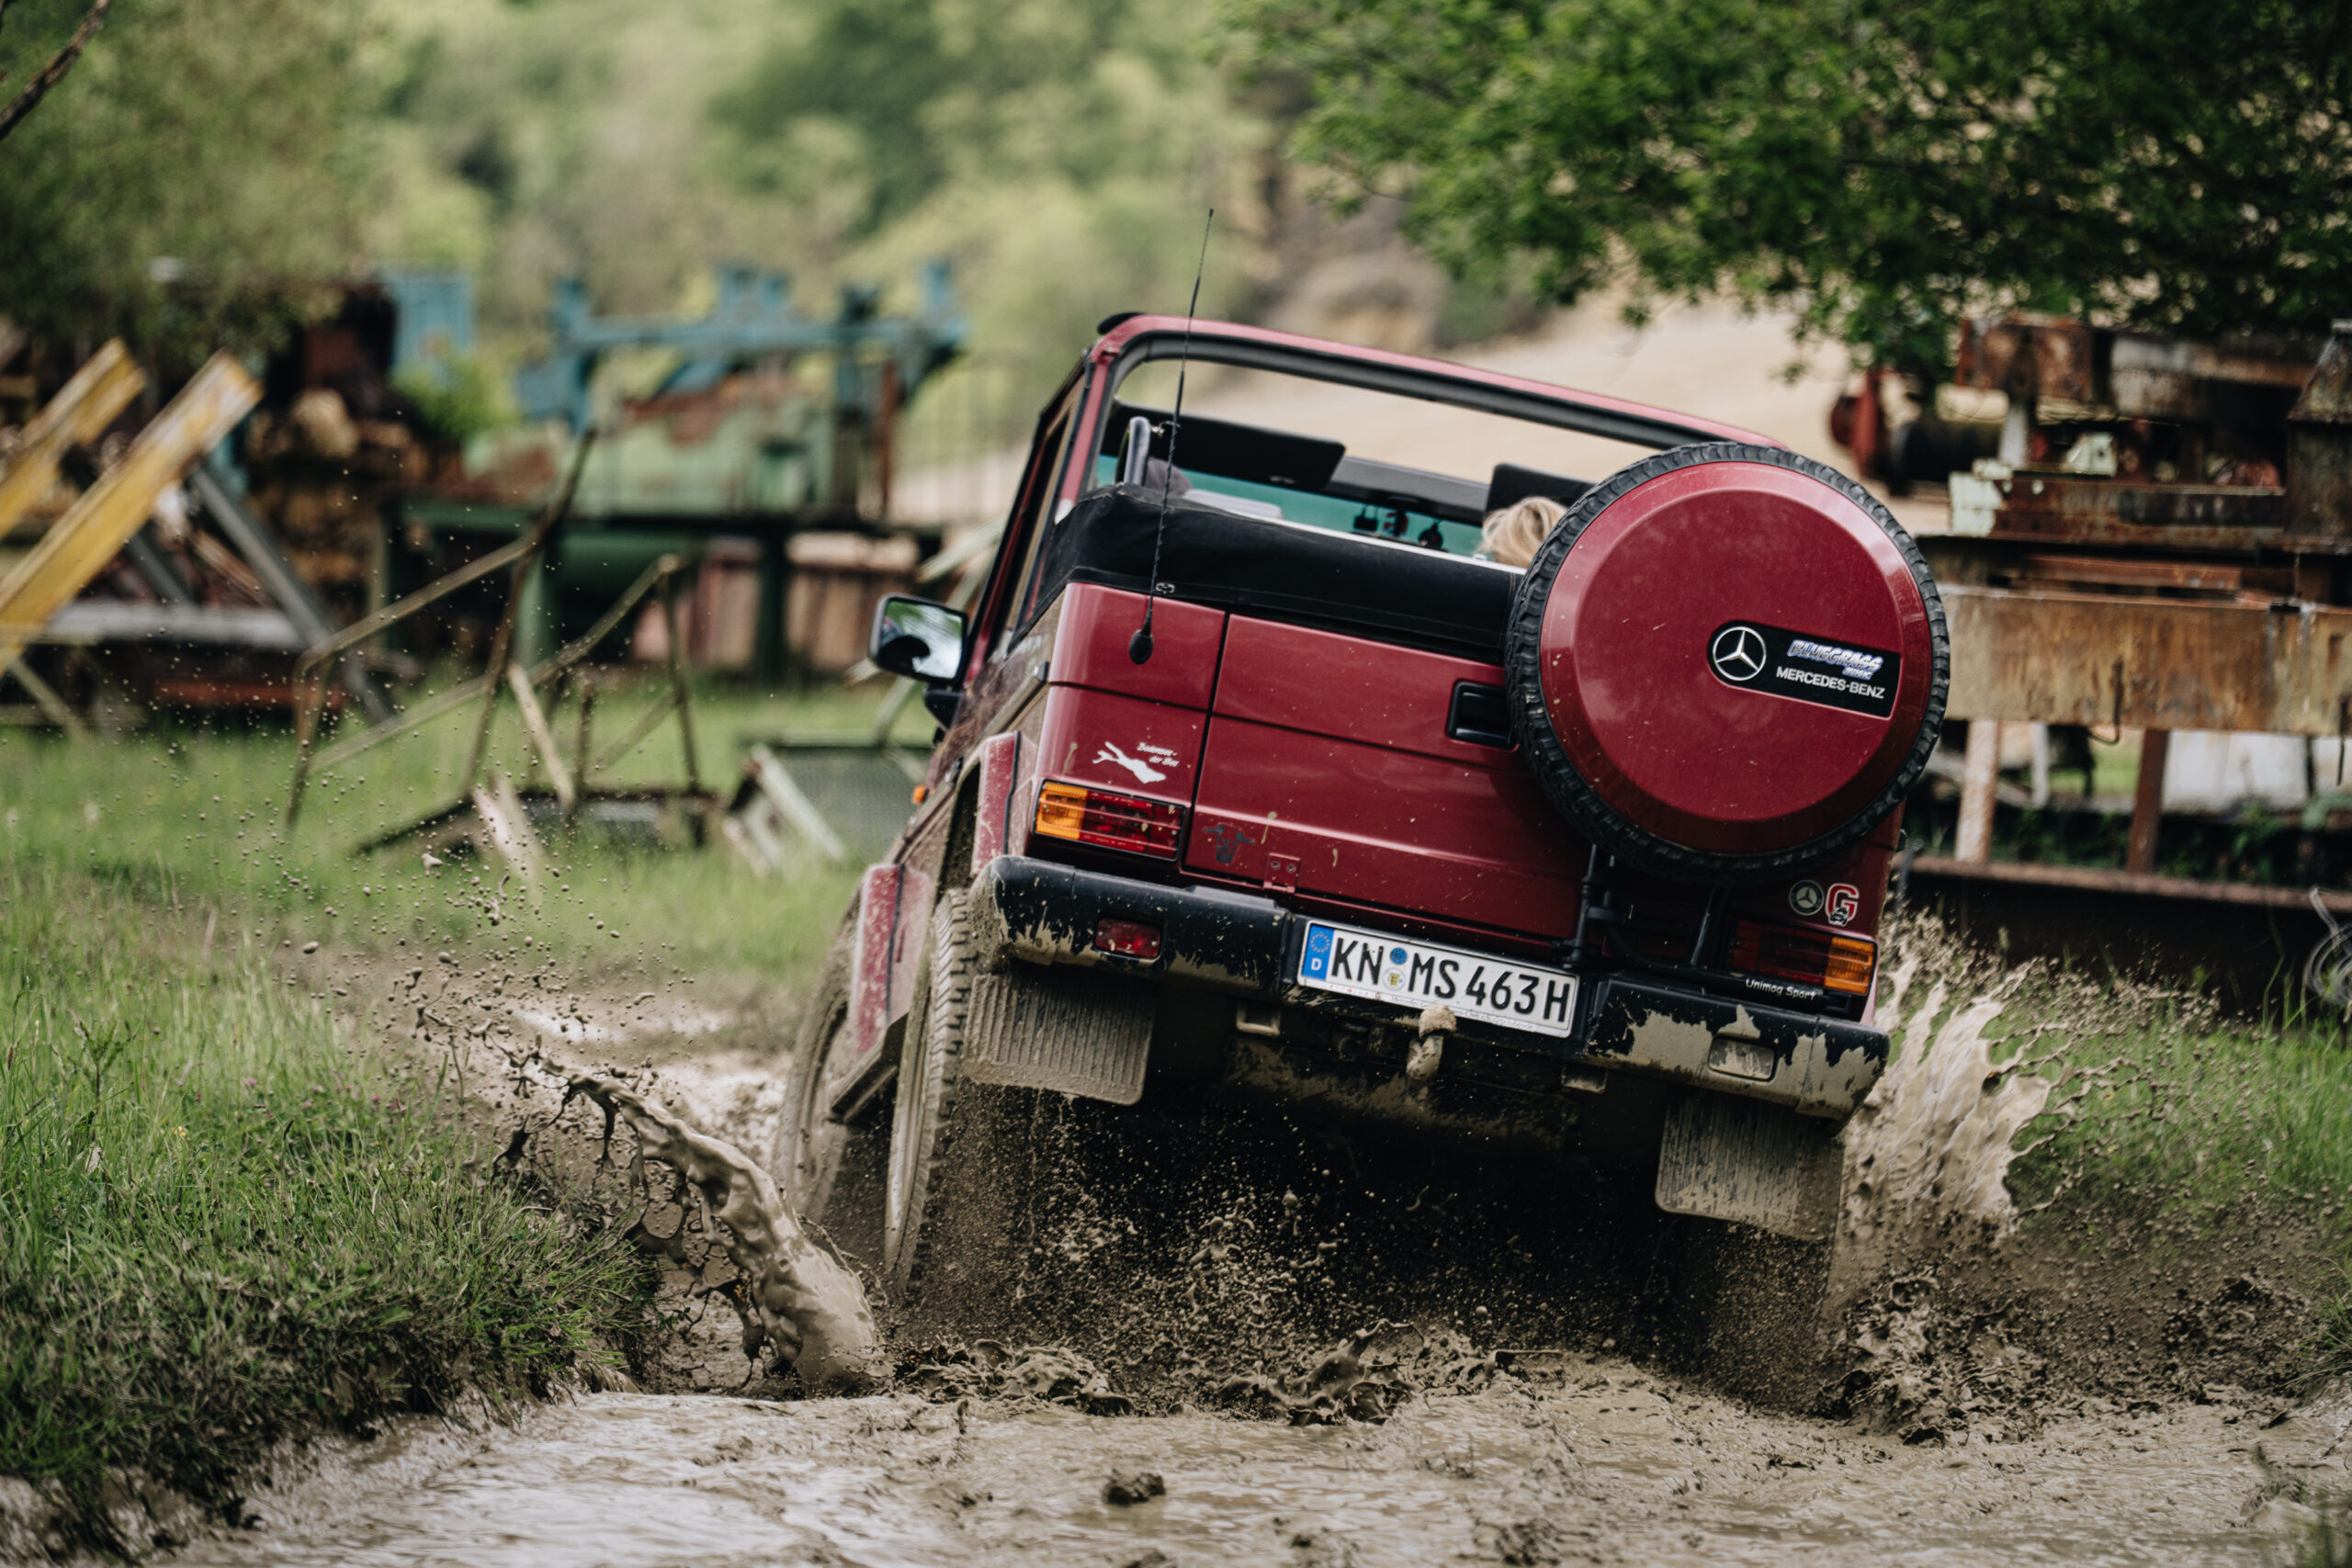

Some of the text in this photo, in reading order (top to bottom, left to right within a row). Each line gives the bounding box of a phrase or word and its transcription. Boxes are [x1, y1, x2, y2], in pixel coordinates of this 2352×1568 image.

[1787, 639, 1883, 671] BLUEGRASS
[1776, 666, 1885, 699] MERCEDES-BENZ
[1311, 958, 1322, 971] D
[1331, 938, 1570, 1022] KN MS 463H
[1746, 978, 1817, 1000] Unimog Sport
